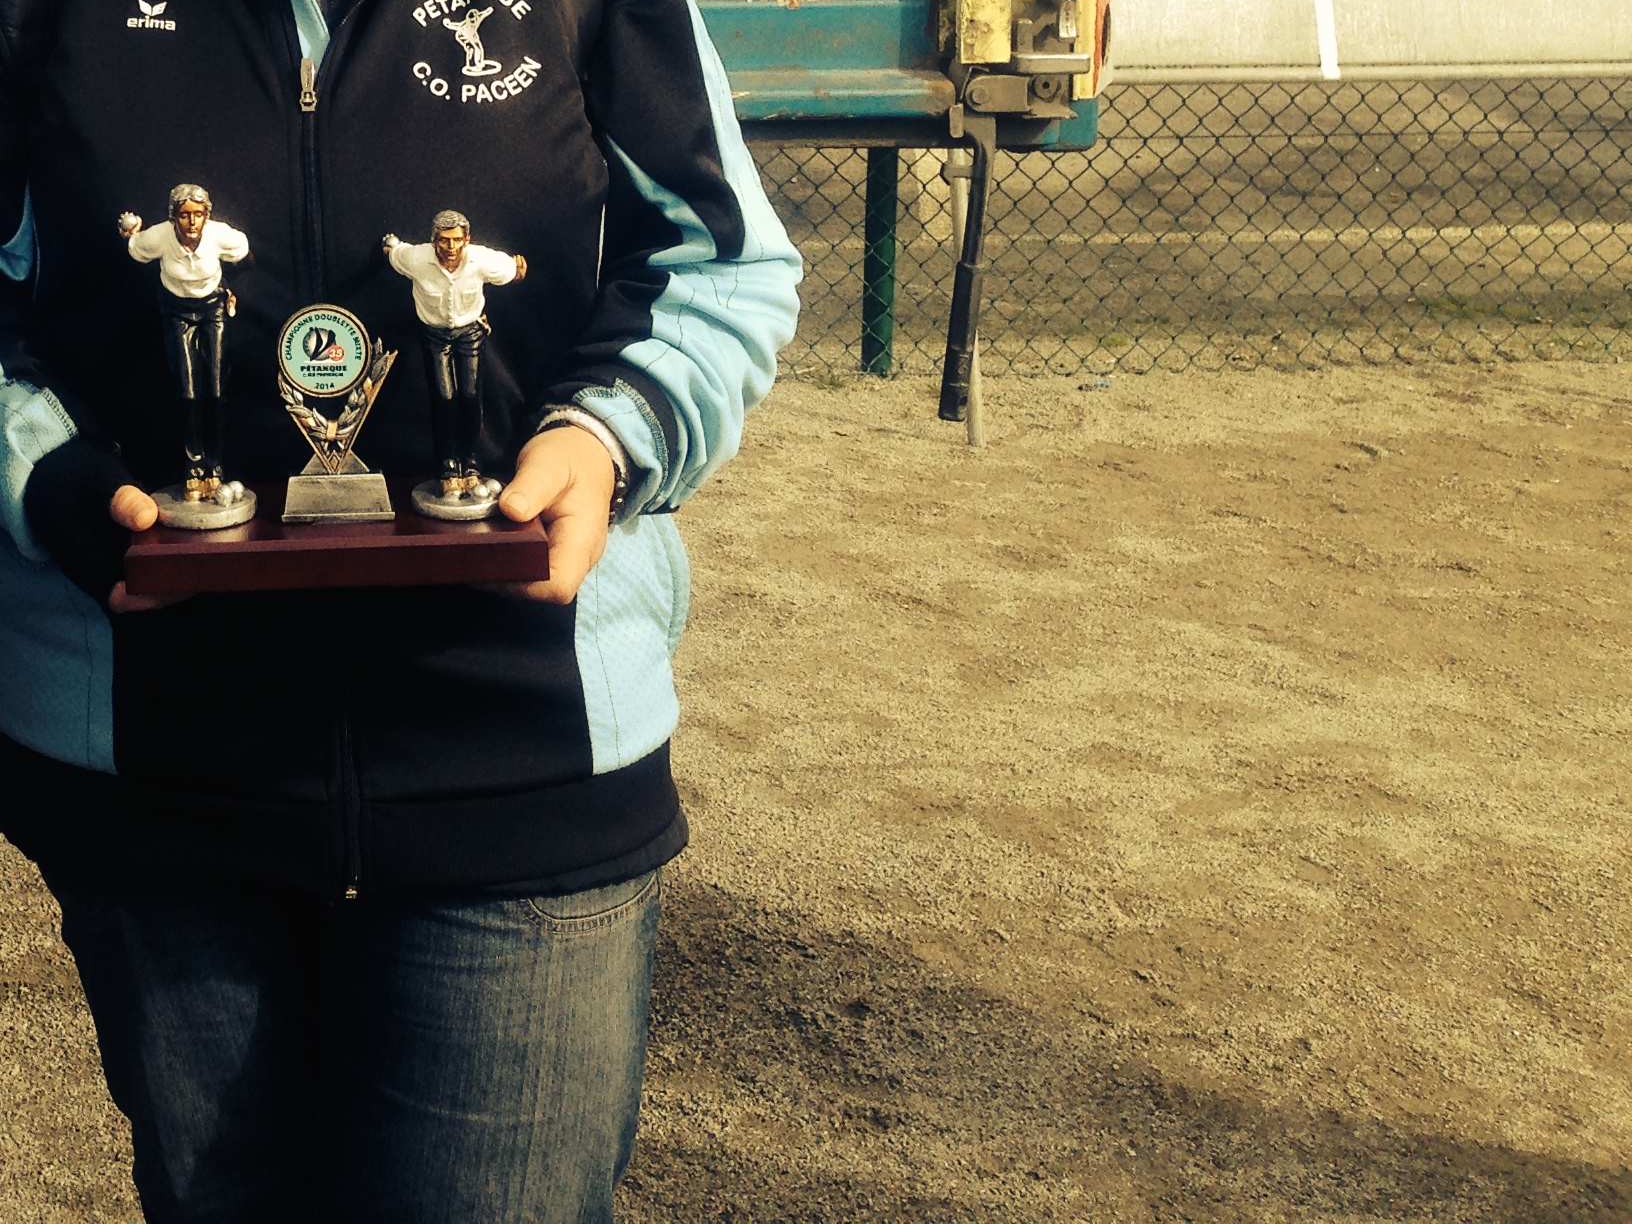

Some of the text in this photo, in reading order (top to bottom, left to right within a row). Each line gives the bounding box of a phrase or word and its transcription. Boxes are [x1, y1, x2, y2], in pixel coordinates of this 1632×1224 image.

[126, 15, 176, 31] erima
[412, 55, 542, 103] C.O. PACEEN
[285, 315, 314, 361] CHAMPIONNE
[314, 313, 357, 336] DOUBLETTE
[314, 382, 336, 390] 2014
